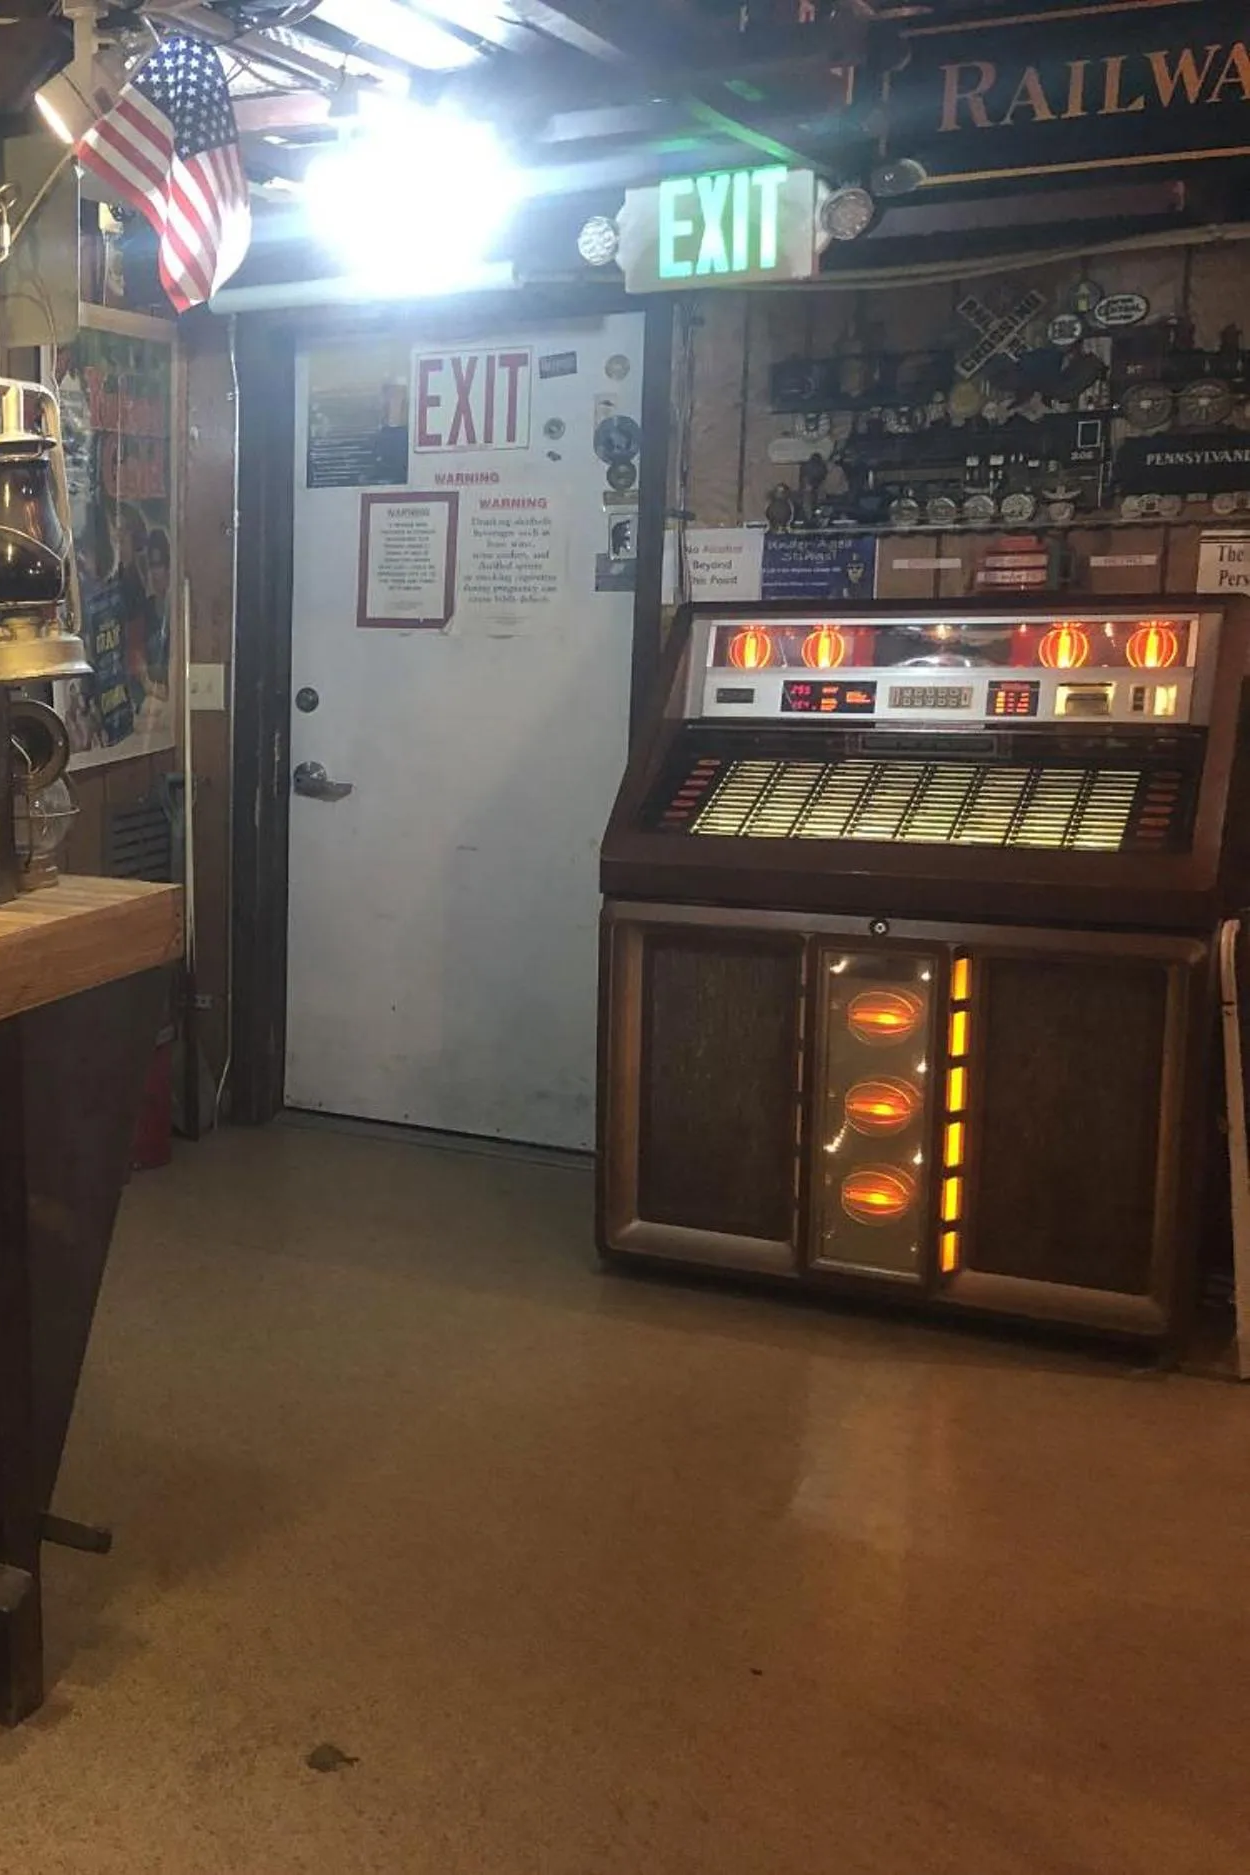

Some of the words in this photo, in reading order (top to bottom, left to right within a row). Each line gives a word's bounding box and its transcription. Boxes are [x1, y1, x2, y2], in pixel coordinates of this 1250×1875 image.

[659, 166, 787, 278] EXIT
[418, 353, 529, 447] EXIT
[435, 472, 500, 485] WARNING
[480, 497, 548, 510] WARNING
[1217, 545, 1245, 562] The
